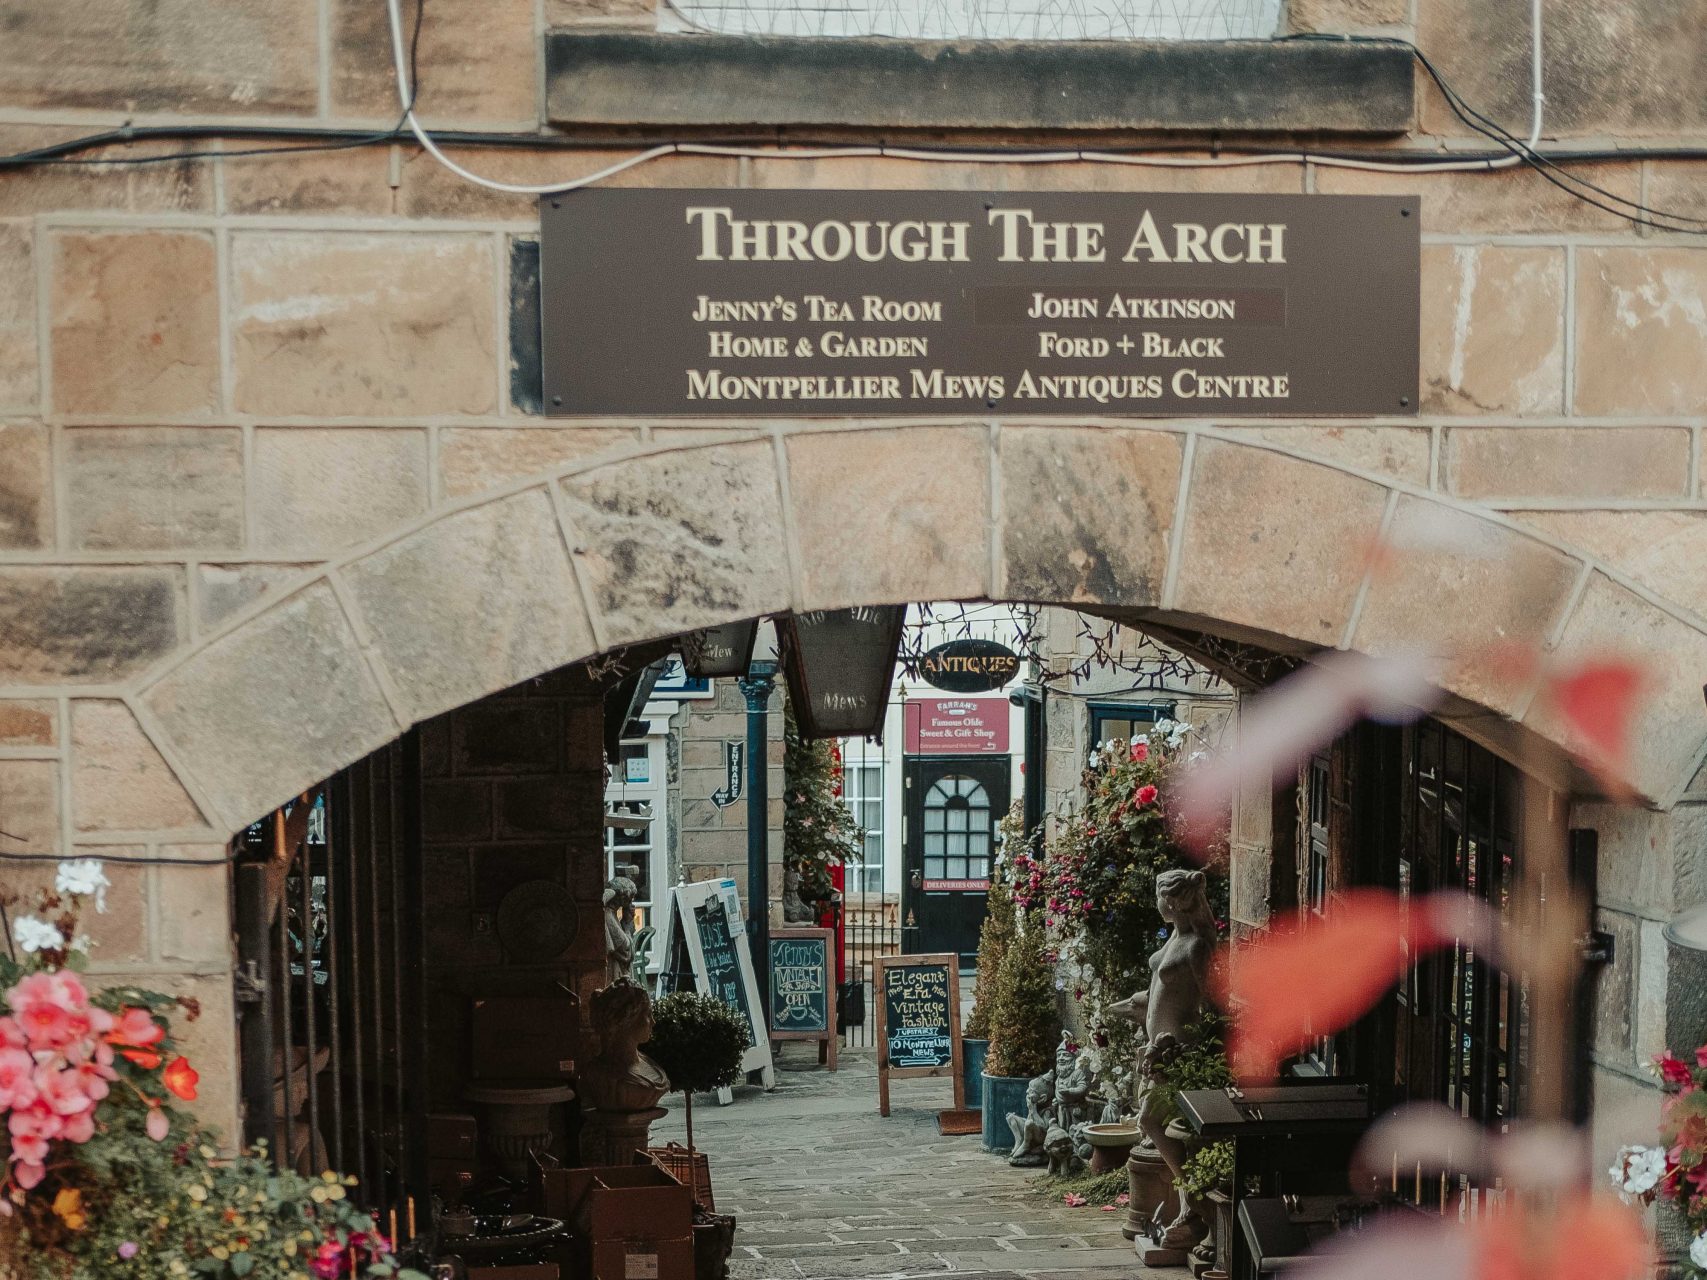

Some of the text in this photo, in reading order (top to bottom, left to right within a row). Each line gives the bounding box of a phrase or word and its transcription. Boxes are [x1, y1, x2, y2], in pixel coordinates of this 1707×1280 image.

[685, 206, 1287, 264] THROUGH THE ARCH
[692, 294, 943, 323] JENNY'S TEA ROOM
[1027, 292, 1236, 320] JOHN ATKINSON
[708, 330, 929, 358] HOME & GARDEN
[1038, 331, 1110, 358] FORD
[1141, 331, 1225, 358] BLACK
[685, 368, 1290, 403] MONTPELLIER MEWS ANTIQUES CENTRE
[924, 655, 1016, 674] ANTIQUES
[931, 718, 984, 727] Famous Olde
[920, 728, 995, 740] Sweet & Gift Shop
[731, 746, 739, 798] ENTRANCE
[926, 881, 986, 889] DELIVERIES ONLY
[888, 969, 945, 989] Elegant
[785, 993, 811, 1006] OPEN
[903, 988, 931, 999] Era
[892, 1001, 945, 1017] Vintage
[902, 1014, 948, 1028] Fashion
[889, 1039, 950, 1049] 10 MONTPELLIER
